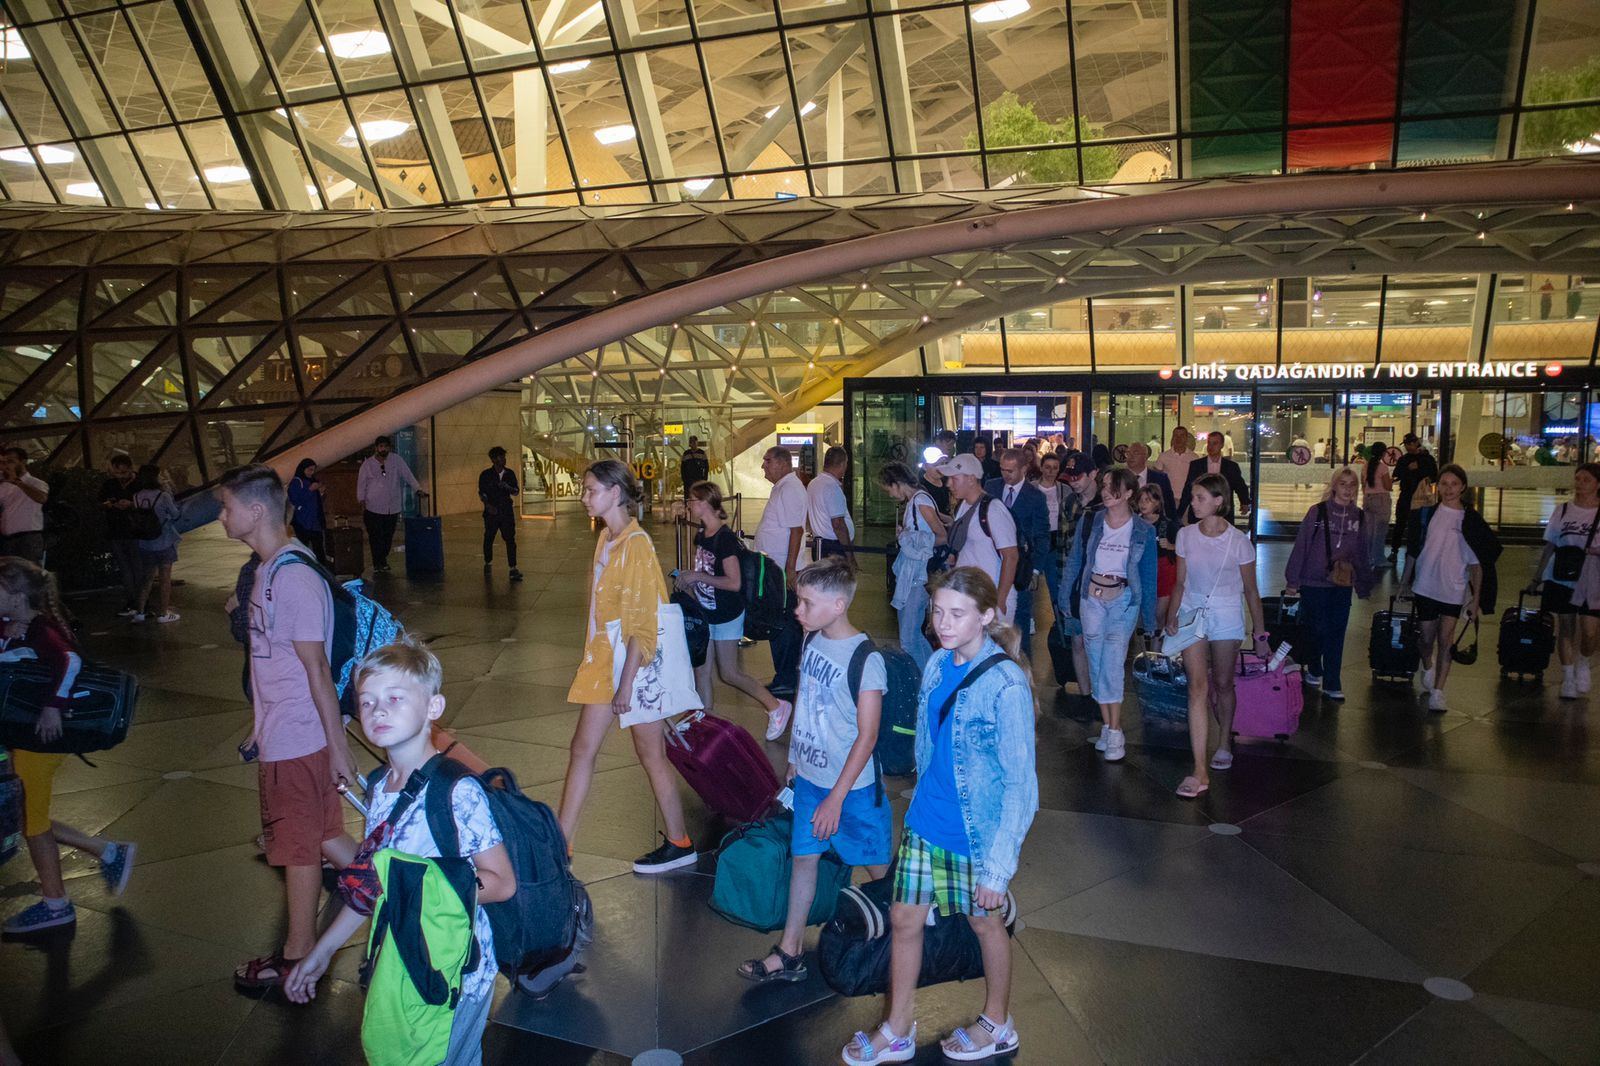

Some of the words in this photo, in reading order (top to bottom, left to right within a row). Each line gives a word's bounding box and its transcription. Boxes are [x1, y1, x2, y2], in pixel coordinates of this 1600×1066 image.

[1178, 363, 1228, 382] GİRİŞ
[1235, 362, 1366, 380] QADAĞANDIR
[1373, 364, 1382, 378] /
[1389, 364, 1419, 378] NO
[1427, 362, 1538, 378] ENTRANCE
[1347, 520, 1360, 532] 14
